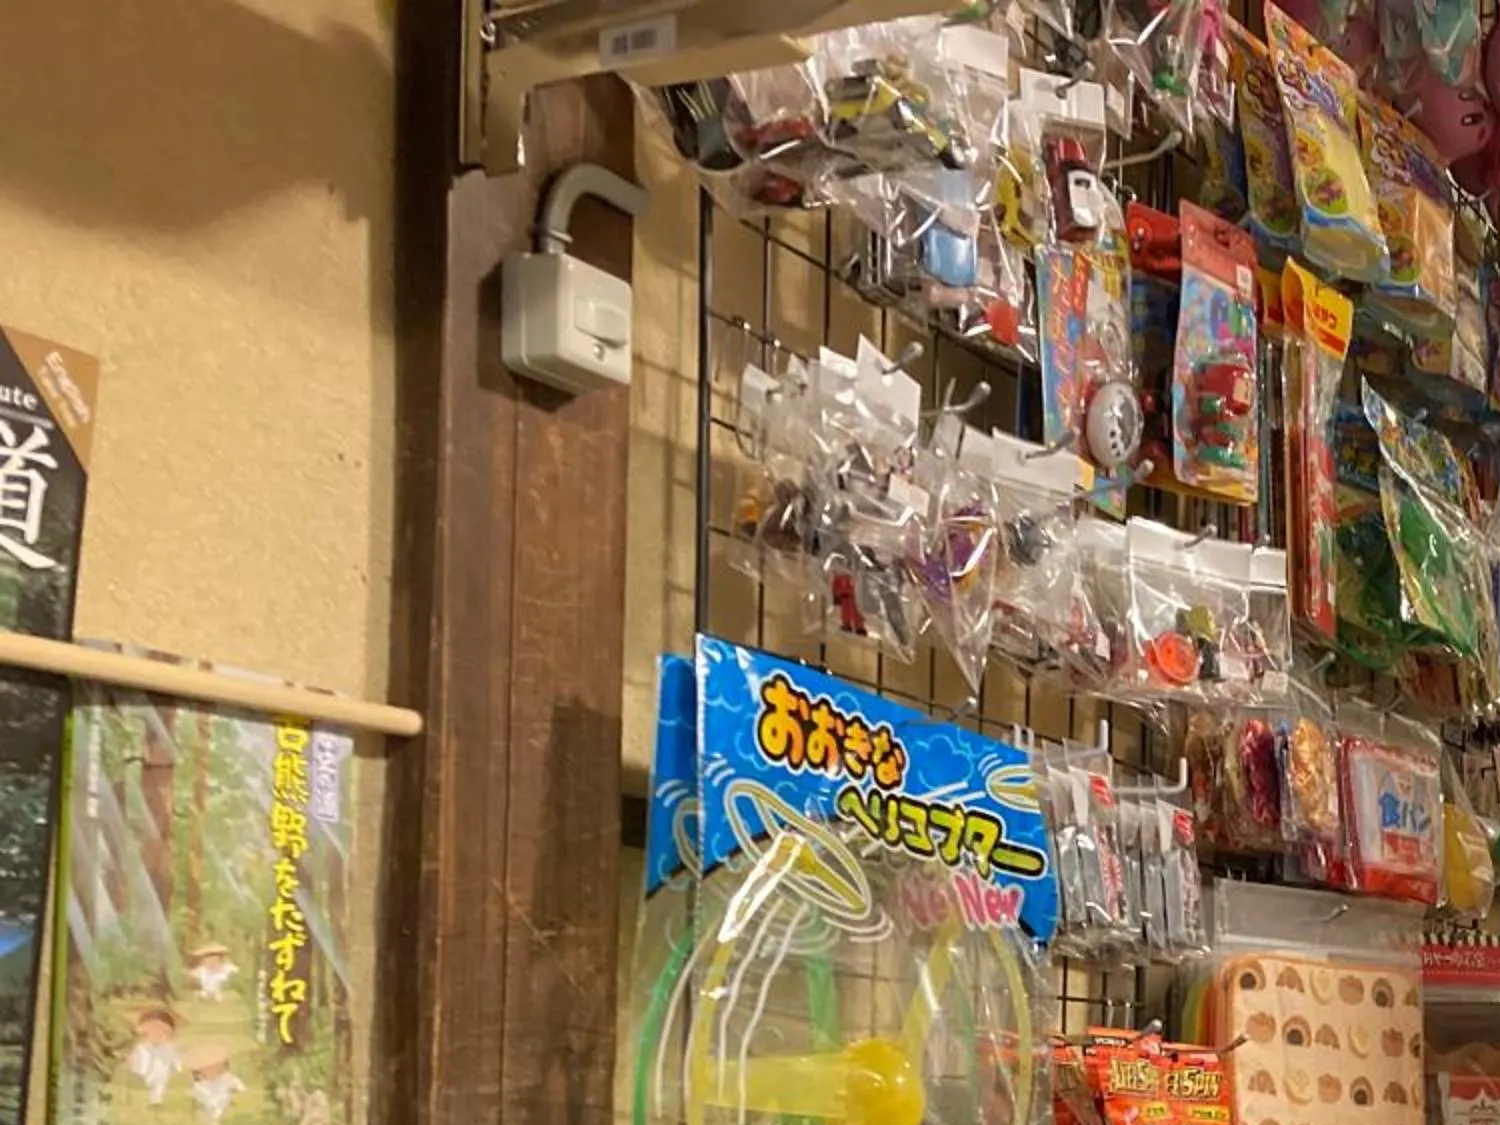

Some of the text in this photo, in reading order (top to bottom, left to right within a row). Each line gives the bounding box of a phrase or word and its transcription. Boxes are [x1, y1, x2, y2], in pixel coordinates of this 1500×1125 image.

[757, 672, 907, 790] おおきな
[837, 785, 1046, 880] ヘリコプター
[953, 872, 1022, 929] New
